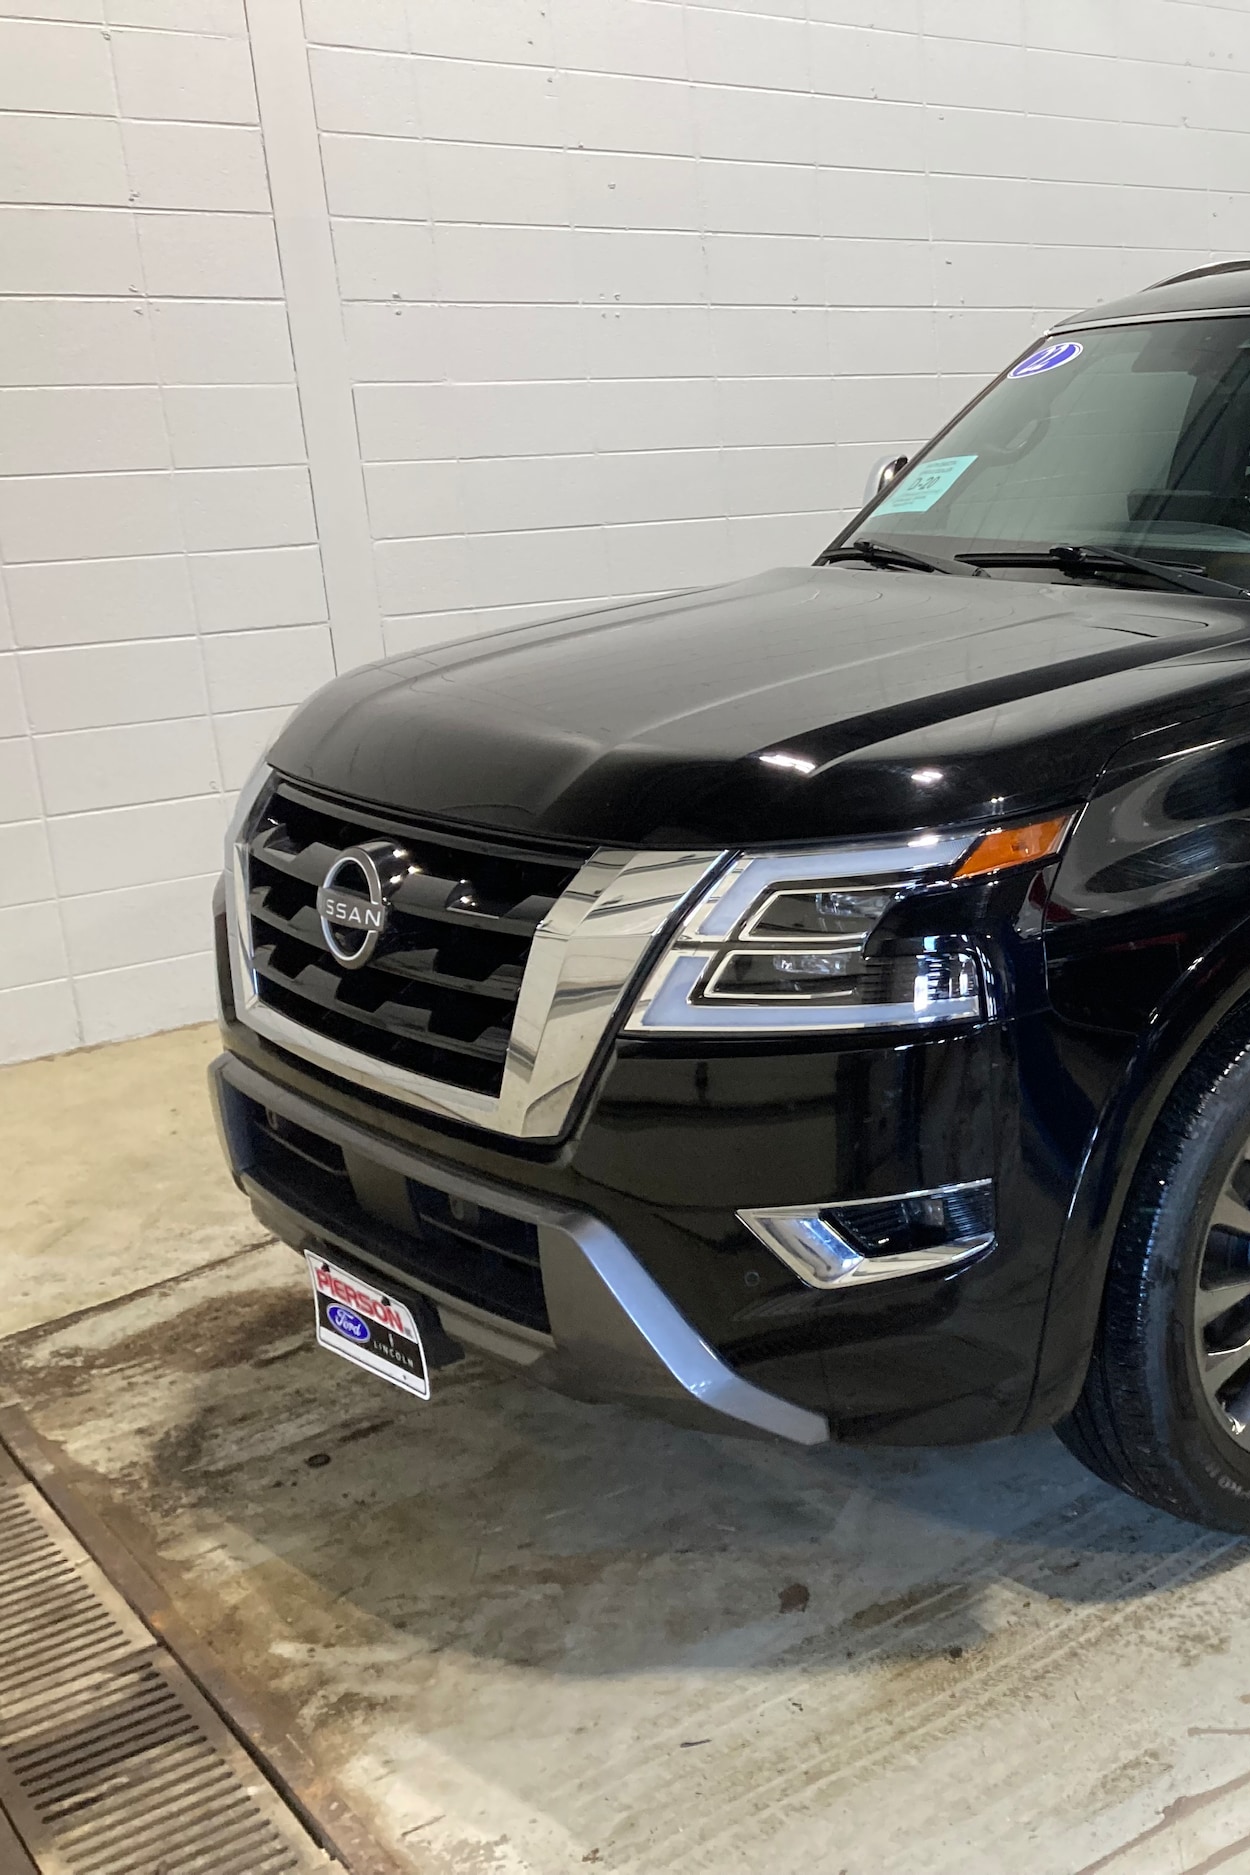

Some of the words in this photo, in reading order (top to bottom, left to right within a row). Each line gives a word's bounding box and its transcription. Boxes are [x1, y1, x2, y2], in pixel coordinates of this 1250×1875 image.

[316, 1269, 404, 1333] PIERSON
[335, 1310, 362, 1337] Ford
[373, 1342, 414, 1368] LINCOLN
